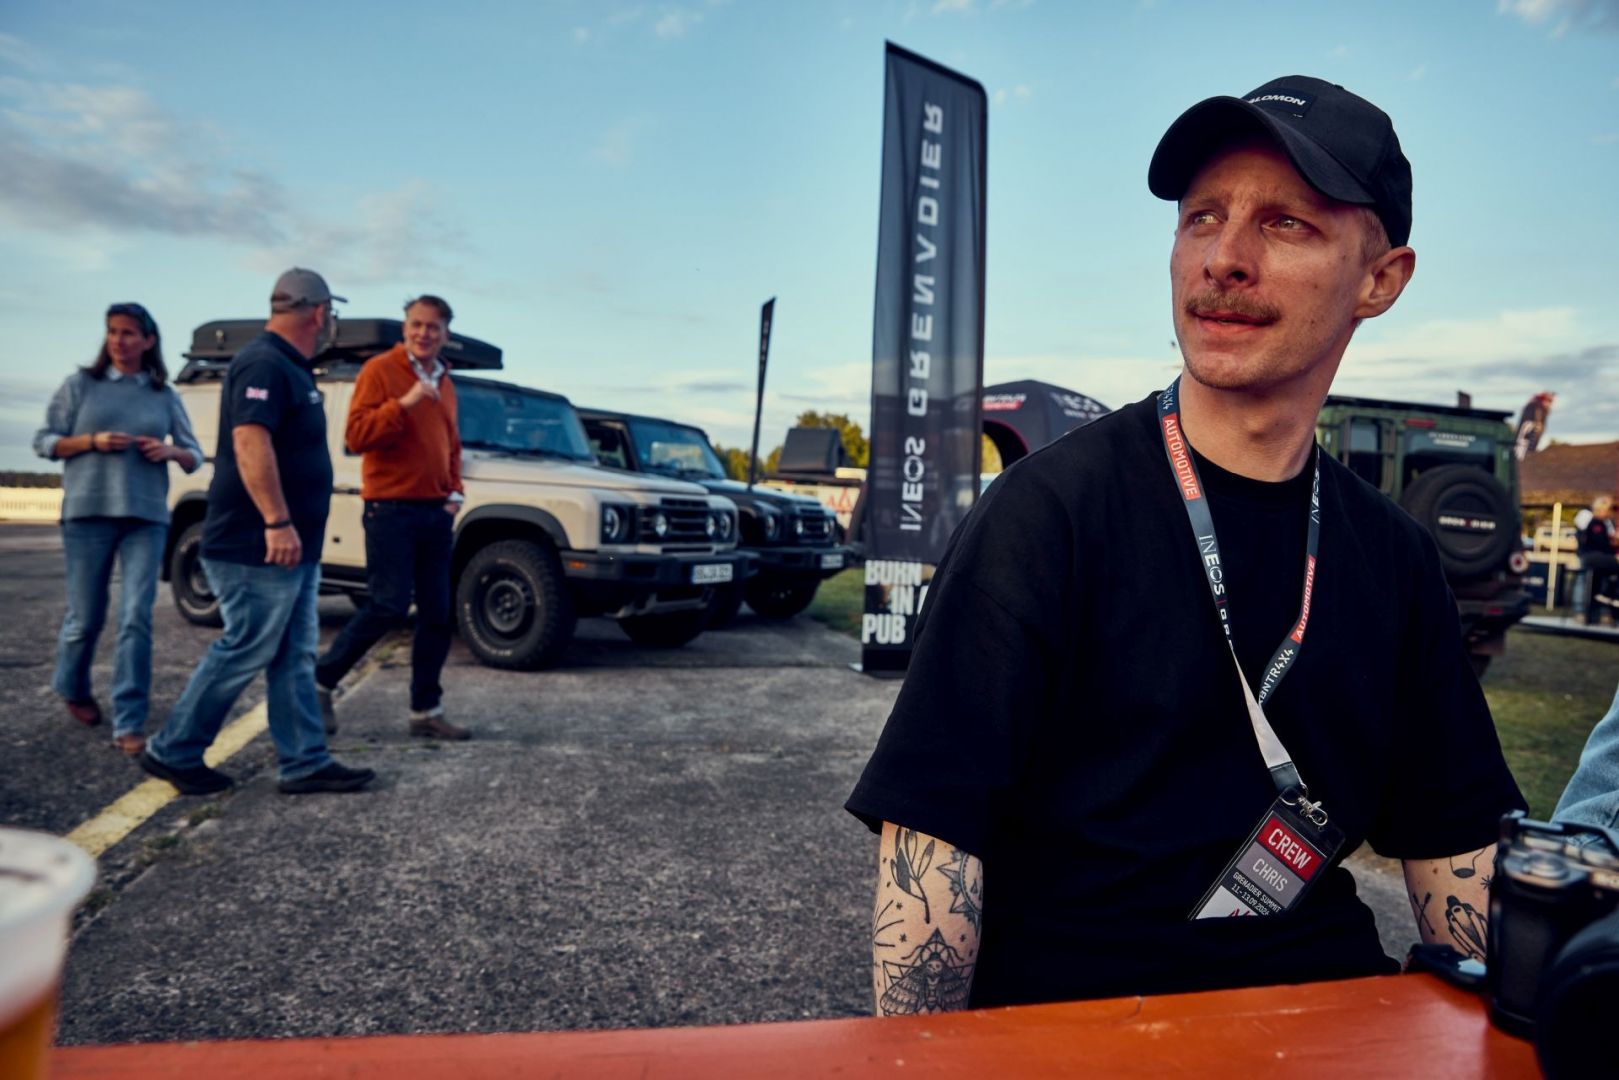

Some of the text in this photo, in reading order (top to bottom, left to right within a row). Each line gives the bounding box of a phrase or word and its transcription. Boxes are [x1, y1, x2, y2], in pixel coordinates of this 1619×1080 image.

[1249, 95, 1306, 105] ALOMON
[1164, 418, 1198, 497] AUTOMOTIVE
[1199, 534, 1226, 596] INEOS
[891, 585, 914, 616] IN
[1296, 558, 1316, 640] AUTOMOTIVE
[862, 613, 906, 644] PUB
[1268, 828, 1312, 869] CREW
[1232, 871, 1282, 913] GRENADIER SUMMIT
[1252, 858, 1288, 892] CHRIS
